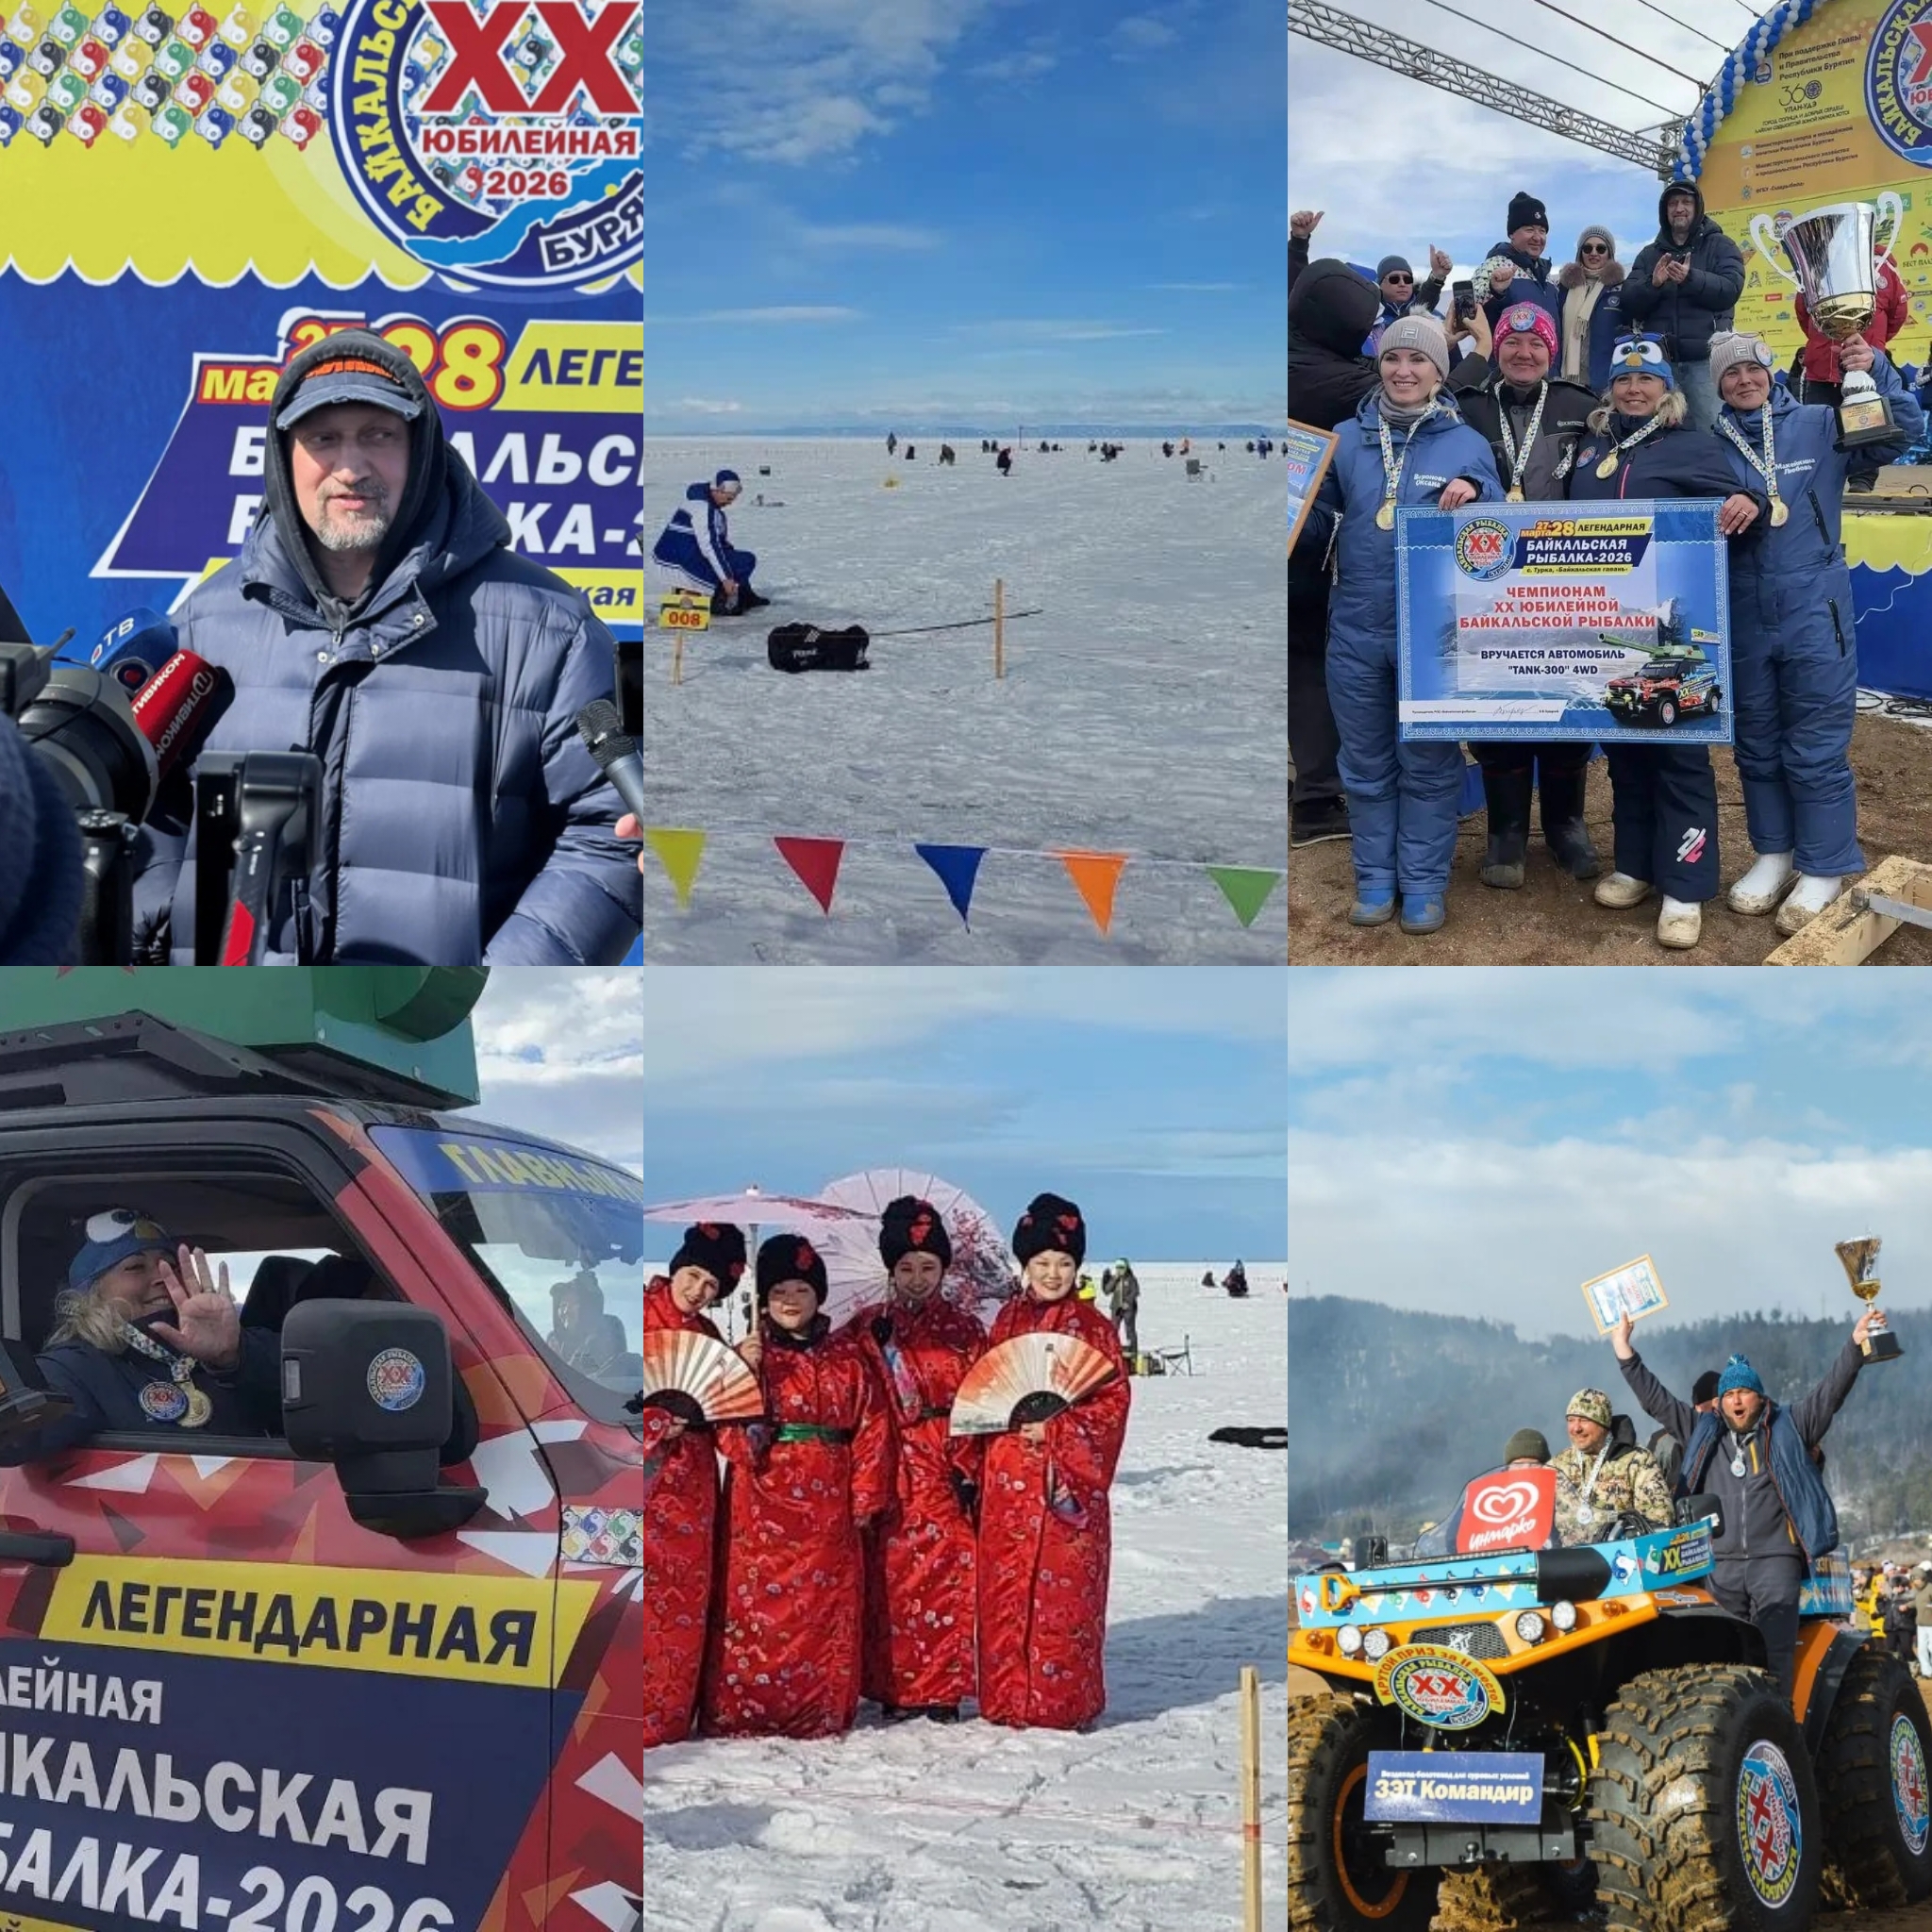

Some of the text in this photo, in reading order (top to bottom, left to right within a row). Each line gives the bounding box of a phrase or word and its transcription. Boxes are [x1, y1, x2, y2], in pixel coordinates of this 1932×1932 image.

[353, 0, 445, 231] БАЙКАЛЬС
[422, 124, 638, 156] ЮБИЛЕЙНАЯ
[486, 171, 568, 195] 2026
[1521, 530, 1553, 539] марта
[1578, 524, 1645, 532] ЛЕГЕНДАРНАЯ
[1526, 538, 1627, 551] БАЙКАЛЬСКАЯ
[1526, 553, 1632, 563] РЫБАЛКА-2026
[1507, 586, 1606, 597] ЧЕМПИОНАМ
[1520, 598, 1619, 612] ЮБИЛЕЙНОЙ
[668, 611, 701, 626] 008
[1460, 612, 1656, 628] БАЙКАЛЬСКОЙ РЫБАЛКИ
[1481, 649, 1625, 659] ВРУЧАЕТСЯ АВТОМОБИЛЬ
[1508, 665, 1598, 675] "TANK-300" 4WD
[81, 1580, 538, 1667] ЛЕГЕНДАРНАЯ
[1378, 1656, 1397, 1696] КРУТОЙ
[1396, 1647, 1436, 1663] ПРИЗ
[0, 1732, 434, 1866] КАЛЬСКАЯ
[1421, 1780, 1535, 1806] Командир
